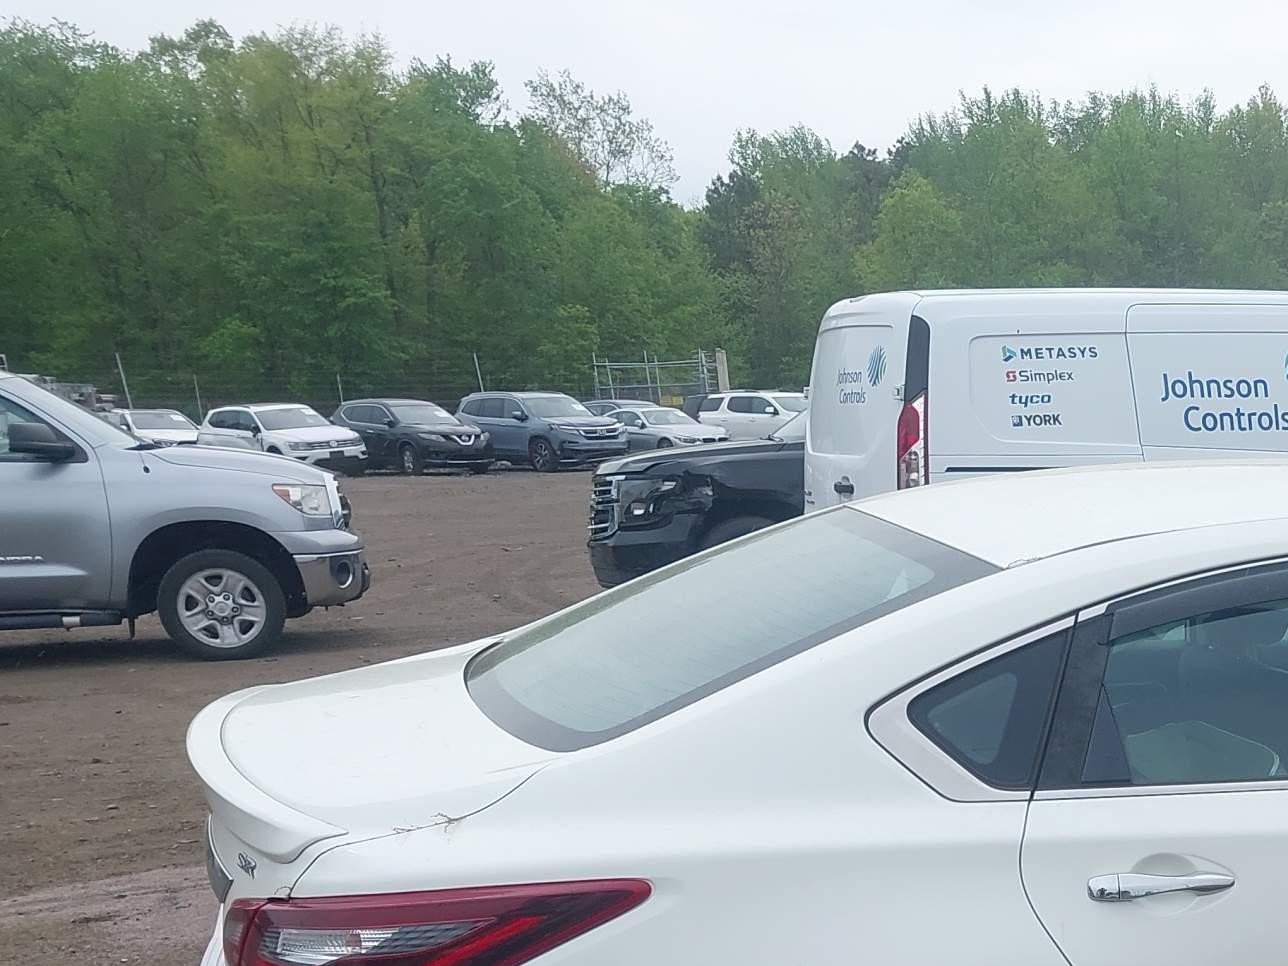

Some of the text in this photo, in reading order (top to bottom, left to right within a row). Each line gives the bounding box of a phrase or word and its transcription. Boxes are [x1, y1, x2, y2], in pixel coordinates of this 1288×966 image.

[1020, 346, 1098, 360] METASYS
[836, 367, 862, 387] Johnson
[1018, 369, 1074, 384] Simplex
[839, 385, 867, 404] Controls
[1160, 371, 1269, 402] Johnson
[1009, 392, 1052, 408] tyco
[1024, 413, 1063, 427] YORK
